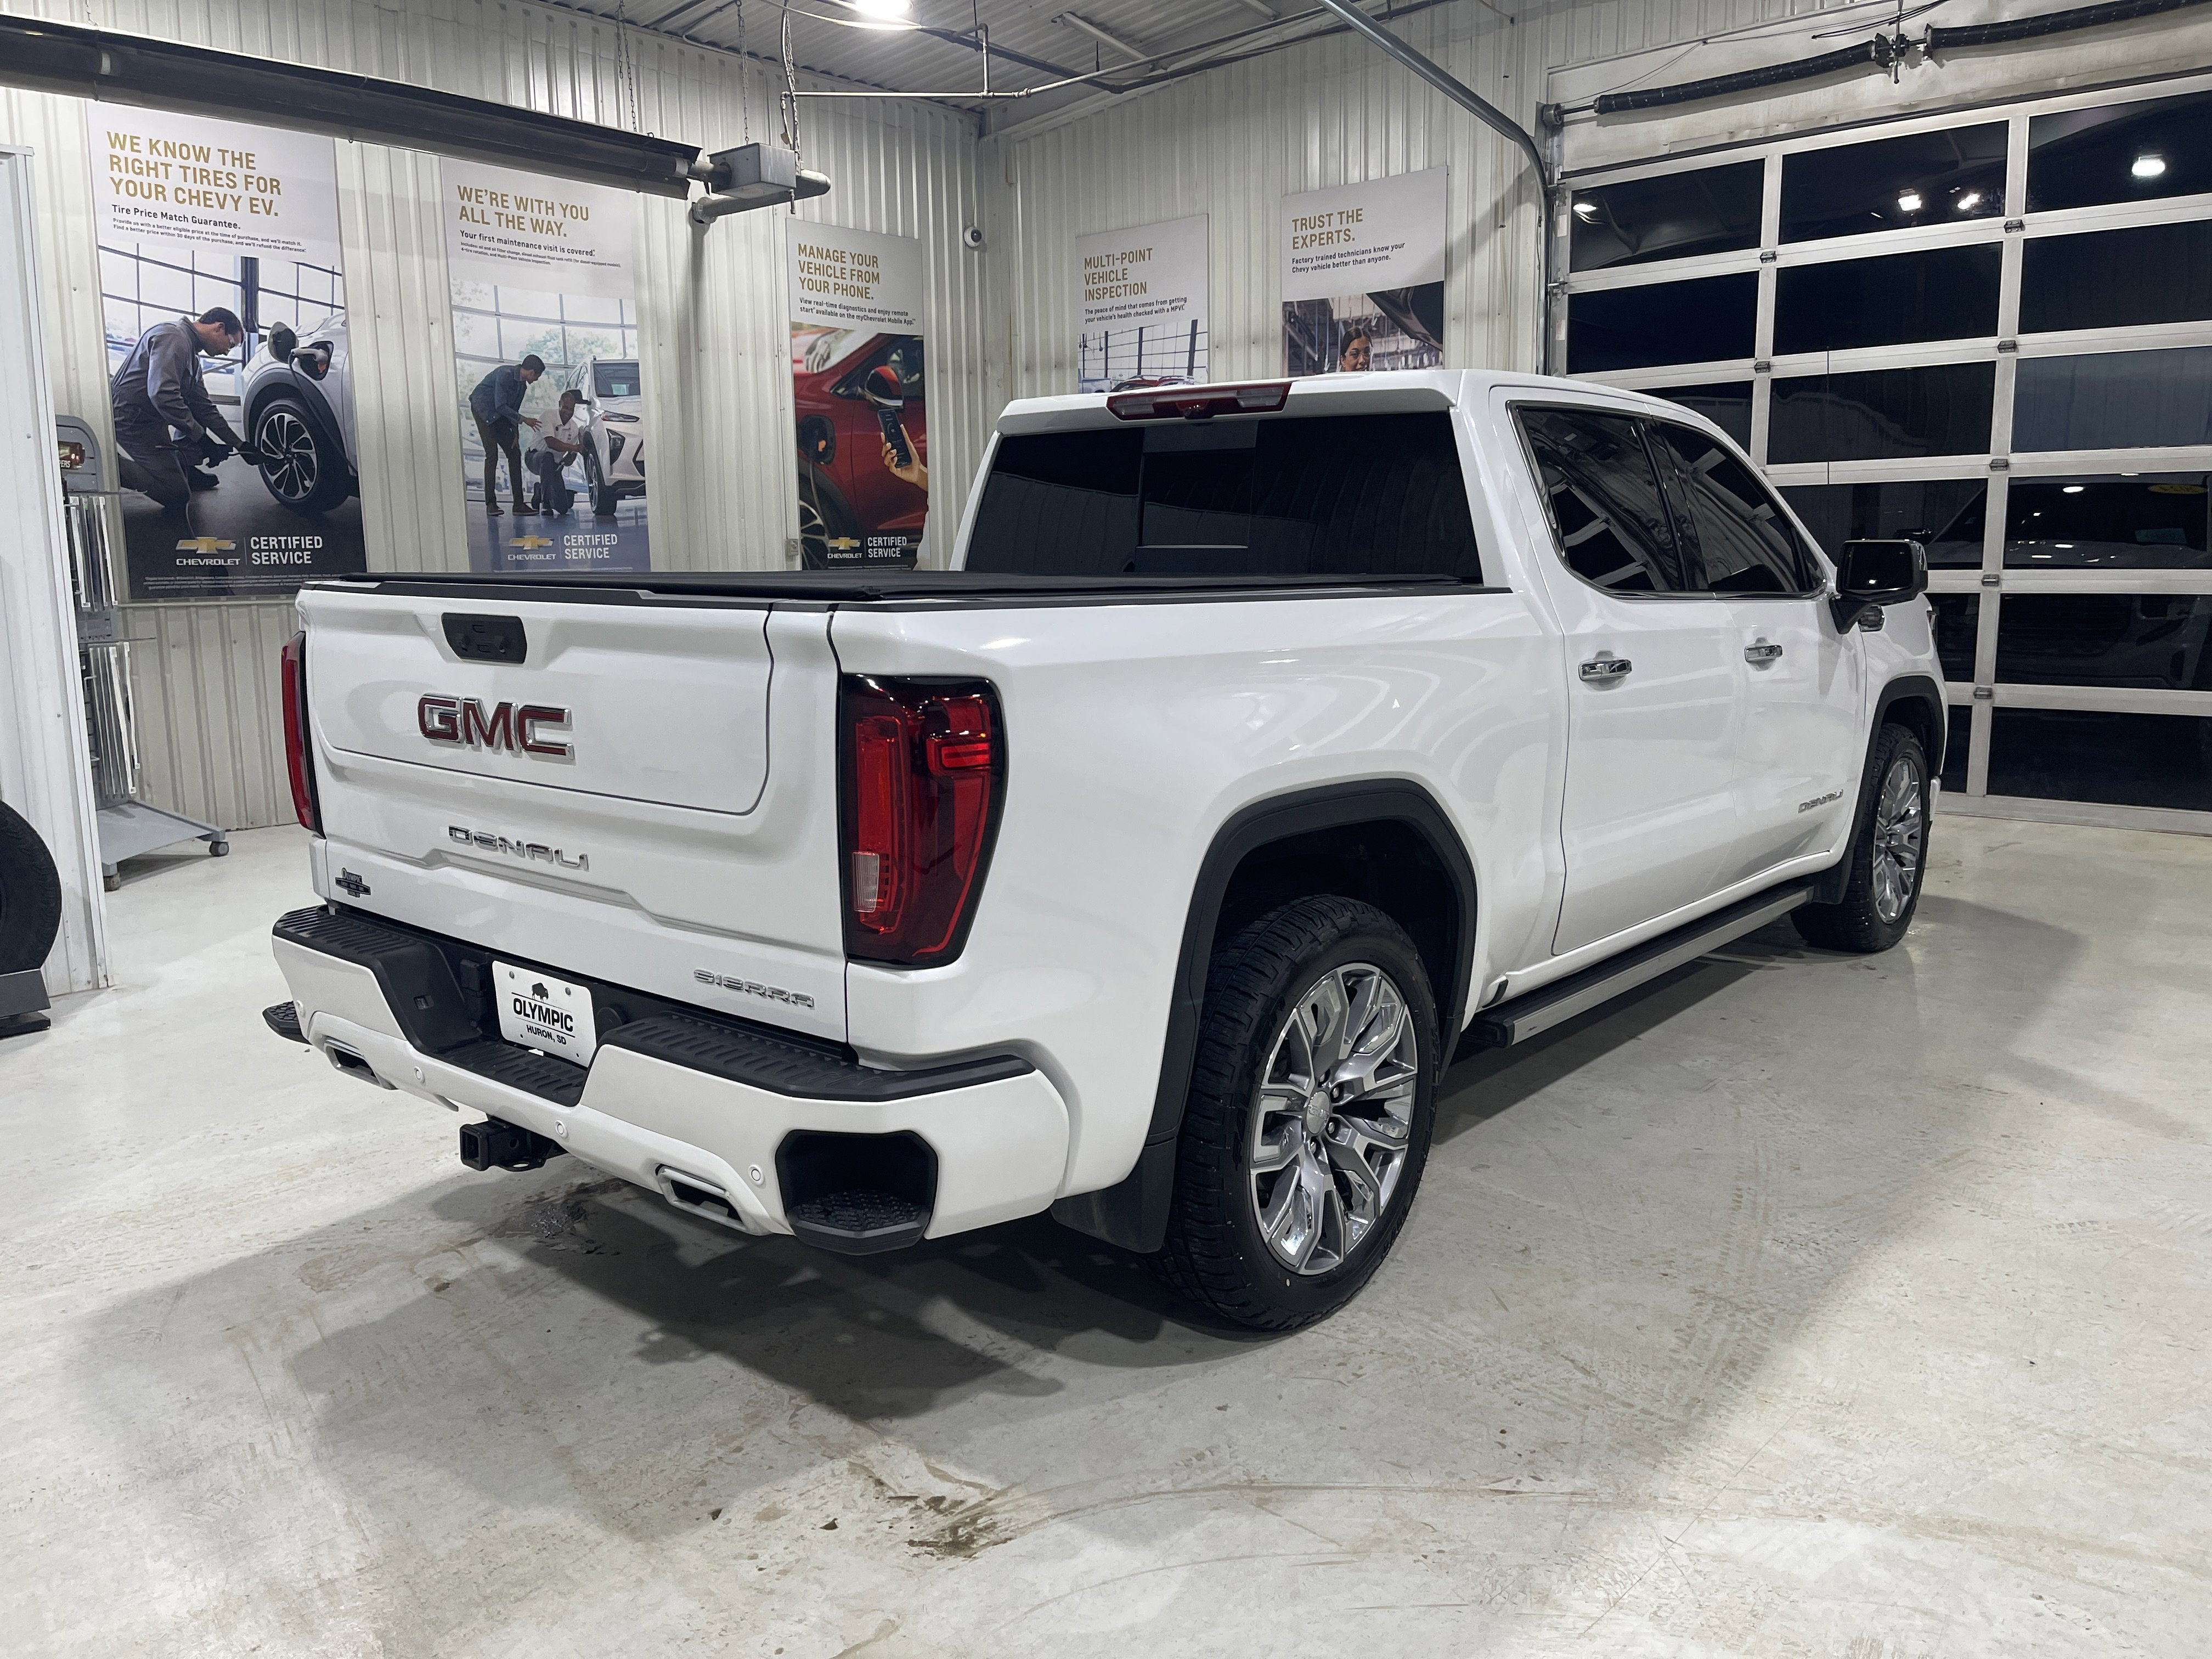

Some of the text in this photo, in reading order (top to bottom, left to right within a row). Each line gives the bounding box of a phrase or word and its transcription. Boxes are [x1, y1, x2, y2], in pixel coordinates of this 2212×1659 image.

[107, 132, 256, 170] WE KNOW THE
[110, 154, 281, 195] RIGHT TIRES FOR
[110, 177, 279, 217] YOUR CHEVY EV.
[457, 185, 589, 221] WE'RE WITH YOU
[112, 204, 241, 229] Tire Price Match Guarantee.
[459, 206, 567, 237] ALL THE WAY.
[1292, 207, 1363, 233] TRUST THE
[460, 229, 477, 240] Your
[479, 233, 495, 243] first
[497, 236, 541, 250] maintenance
[544, 243, 558, 253] visit
[1293, 228, 1355, 250] EXPERTS.
[798, 243, 878, 268] MANAGE YOUR
[1085, 247, 1153, 270] MULTI-POINT
[1292, 242, 1406, 265] Factory trained technicians know your
[1292, 266, 1309, 274] Chevy
[1311, 262, 1331, 271] vehicle
[1332, 259, 1351, 268] better
[1368, 254, 1391, 264] anyone.
[798, 259, 880, 284] VEHICLE FROM
[1085, 268, 1128, 285] VEHICLE
[799, 276, 874, 300] YOUR PHONE.
[1085, 281, 1147, 302] INSPECTION
[799, 297, 812, 305] View
[813, 300, 837, 309] real-time
[839, 303, 867, 313] diagnostics
[816, 309, 838, 317] available
[856, 314, 886, 323] myChevrolet
[1094, 307, 1108, 315] peace
[1169, 296, 1187, 306] getting
[1097, 313, 1116, 321] vehicle's
[1133, 309, 1153, 317] checked
[250, 535, 323, 550] CERTIFIED
[563, 534, 618, 546] CERTIFIED
[867, 537, 907, 547] CERTIFIED
[251, 551, 312, 565] SERVICE
[565, 548, 610, 560] SERVICE
[868, 548, 901, 558] SERVICE
[417, 692, 574, 760] GMC
[1798, 789, 1843, 812] DENALI
[448, 825, 589, 871] DENALI
[693, 969, 815, 1009] SIERRA
[514, 998, 573, 1032] OLYMPIC
[526, 1024, 567, 1045] HURON, SD
